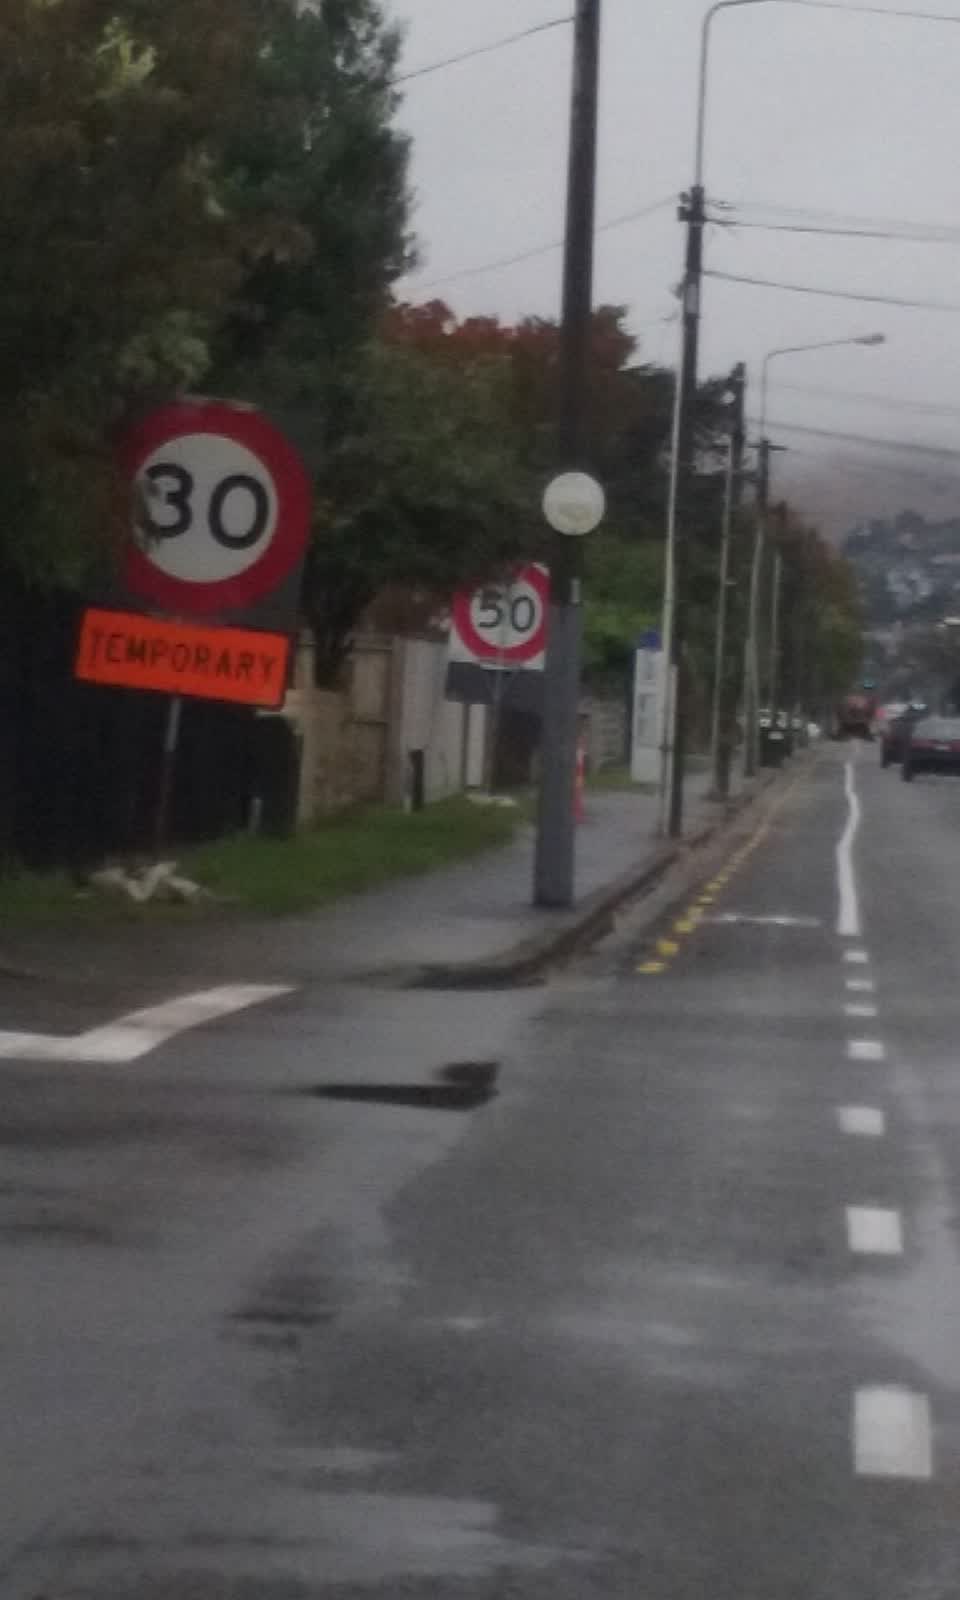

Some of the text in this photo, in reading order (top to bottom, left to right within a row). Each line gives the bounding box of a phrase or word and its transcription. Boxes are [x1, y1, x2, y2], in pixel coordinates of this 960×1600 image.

[145, 463, 270, 550] 30
[477, 589, 536, 633] 50
[88, 630, 279, 681] TEMPORARY
